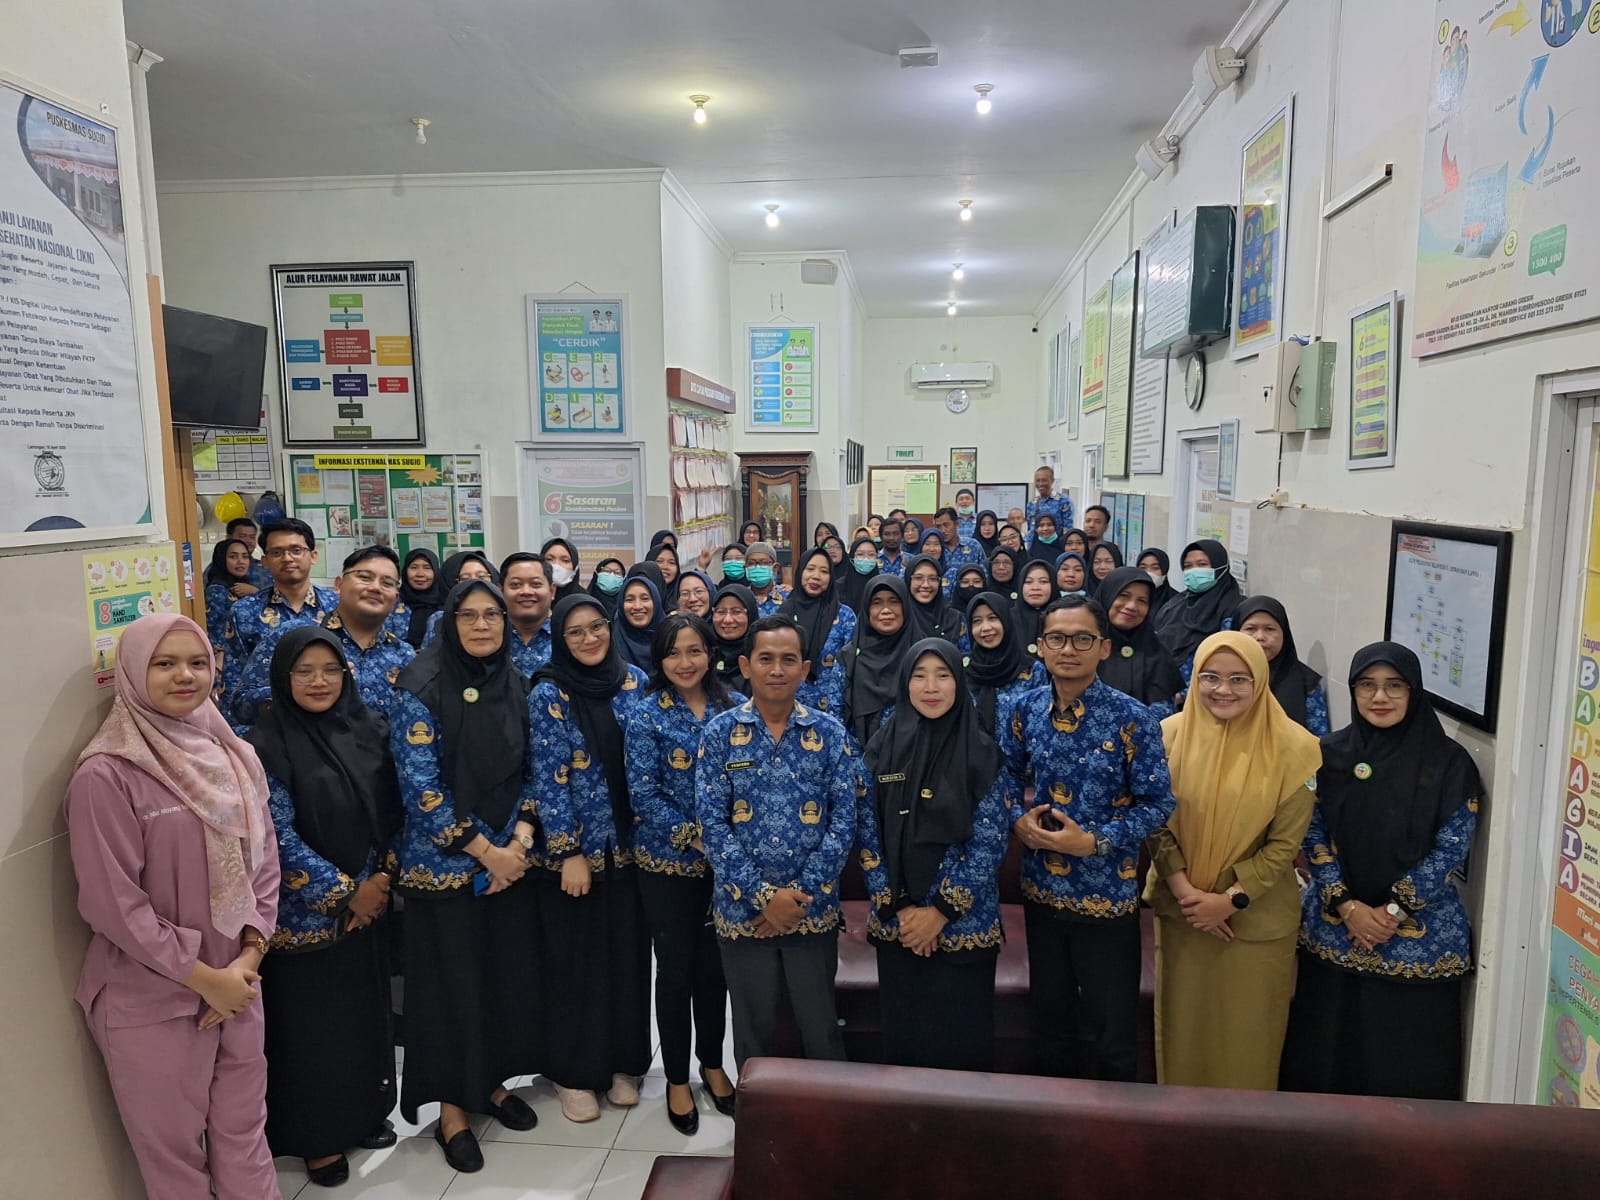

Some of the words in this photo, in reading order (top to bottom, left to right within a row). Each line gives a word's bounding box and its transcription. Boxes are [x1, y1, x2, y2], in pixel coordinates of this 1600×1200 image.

[47, 111, 86, 138] PUSKESMAS
[87, 127, 106, 145] SUGIO
[17, 213, 54, 237] LAYANAN
[0, 228, 36, 251] SEHATAN
[37, 238, 76, 261] NASIONAL
[1508, 235, 1515, 249] 3
[286, 273, 306, 284] ALUR
[307, 272, 349, 284] PELAYANAN
[350, 272, 377, 283] RAWAT
[378, 271, 401, 282] JALAN
[1555, 291, 1574, 304] GRESIK
[13, 358, 35, 369] Dengan
[23, 383, 42, 393] Untuk
[42, 408, 64, 418] Peserta
[10, 419, 35, 429] Dengan
[318, 457, 352, 466] INFORMASI
[401, 458, 422, 466] SUGIO
[565, 494, 617, 506] Sasaran
[99, 601, 111, 625] 8
